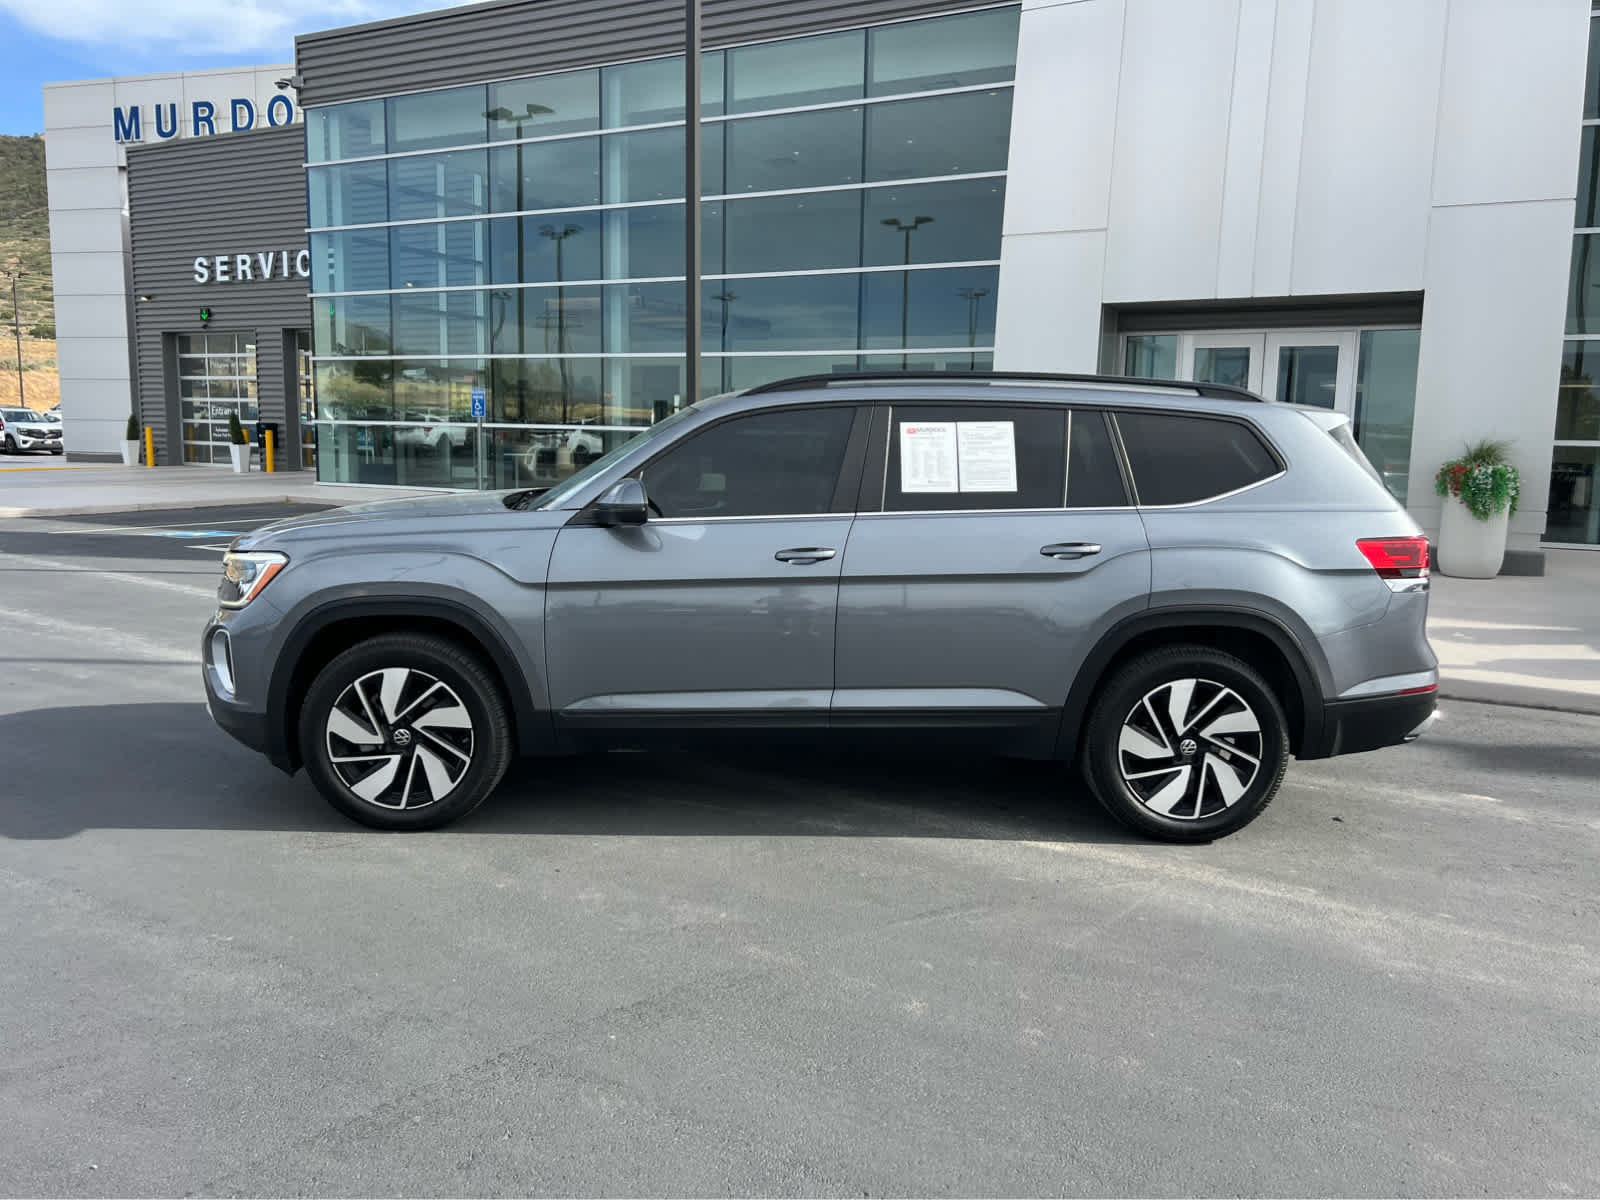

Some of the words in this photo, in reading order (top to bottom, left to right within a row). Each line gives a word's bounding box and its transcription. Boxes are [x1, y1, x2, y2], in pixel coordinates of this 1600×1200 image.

[113, 94, 294, 141] MURDO
[193, 249, 310, 284] SERVIC
[211, 407, 239, 416] Entrane
